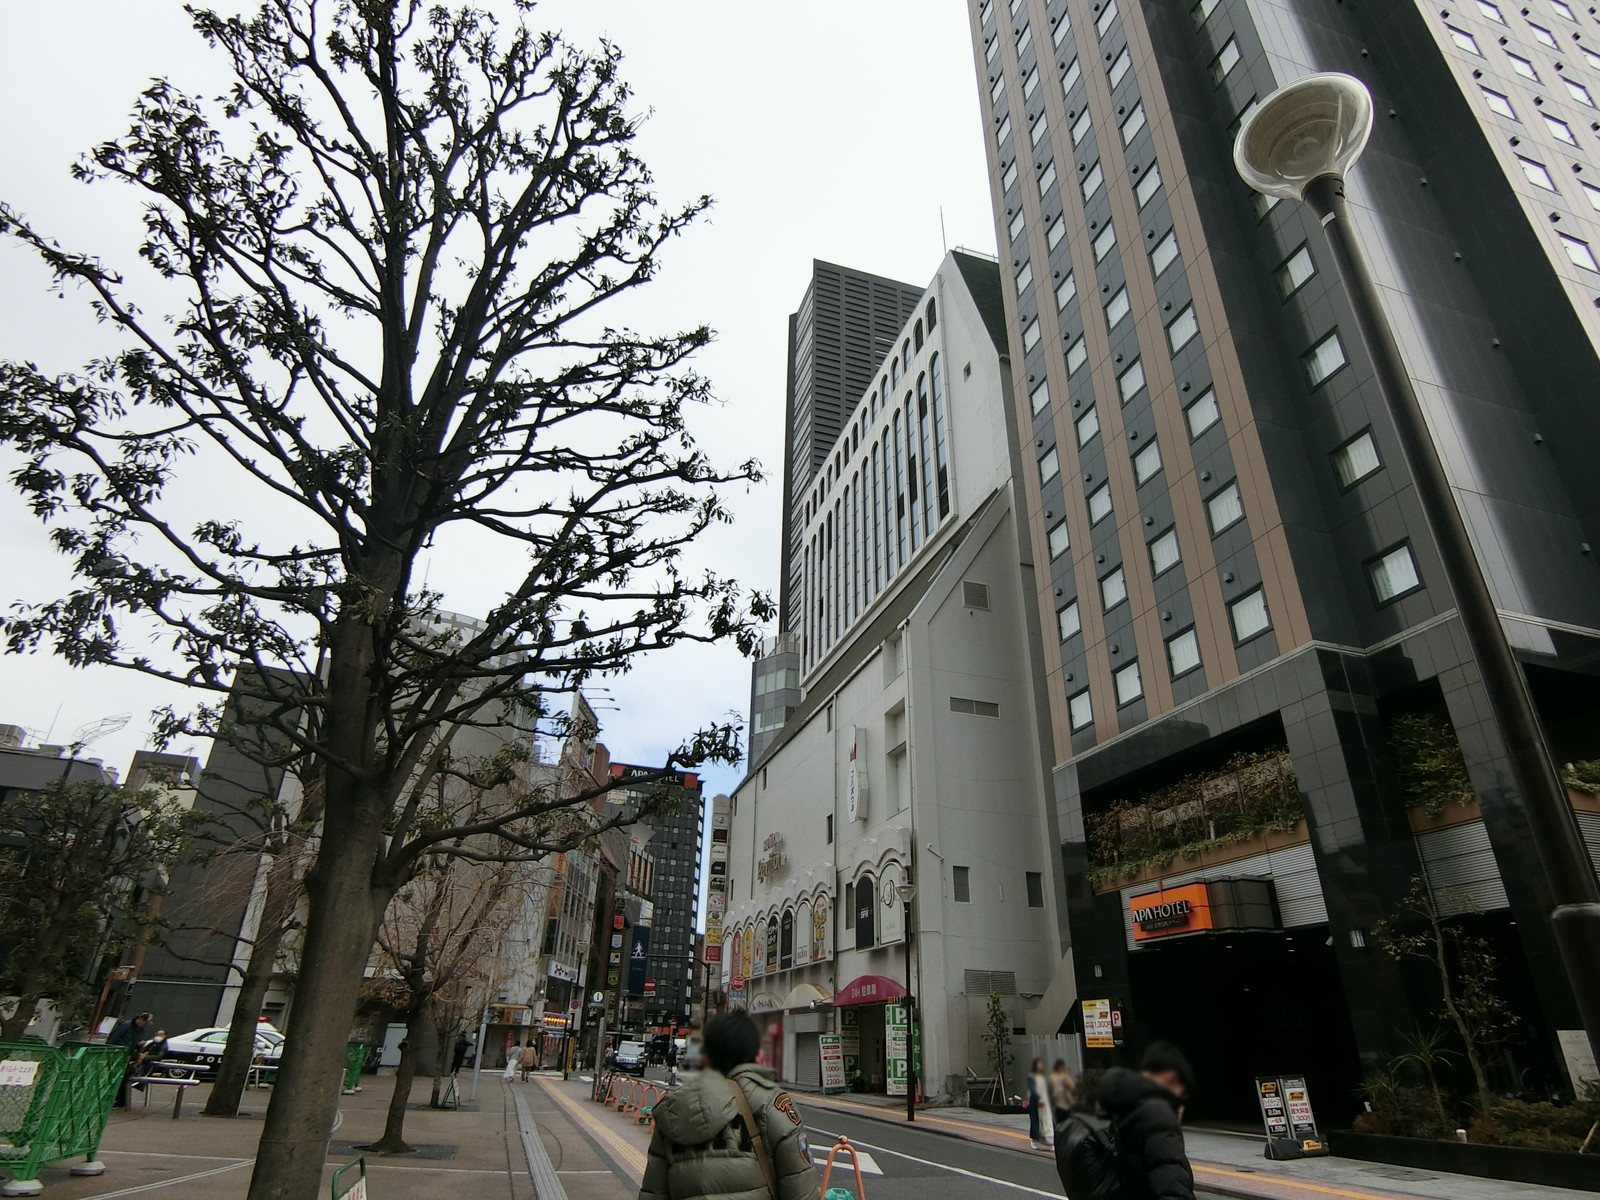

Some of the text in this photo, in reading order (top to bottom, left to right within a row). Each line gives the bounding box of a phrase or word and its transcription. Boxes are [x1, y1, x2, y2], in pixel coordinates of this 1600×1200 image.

[1132, 900, 1190, 922] APA HOTEL
[1114, 1013, 1119, 1024] P
